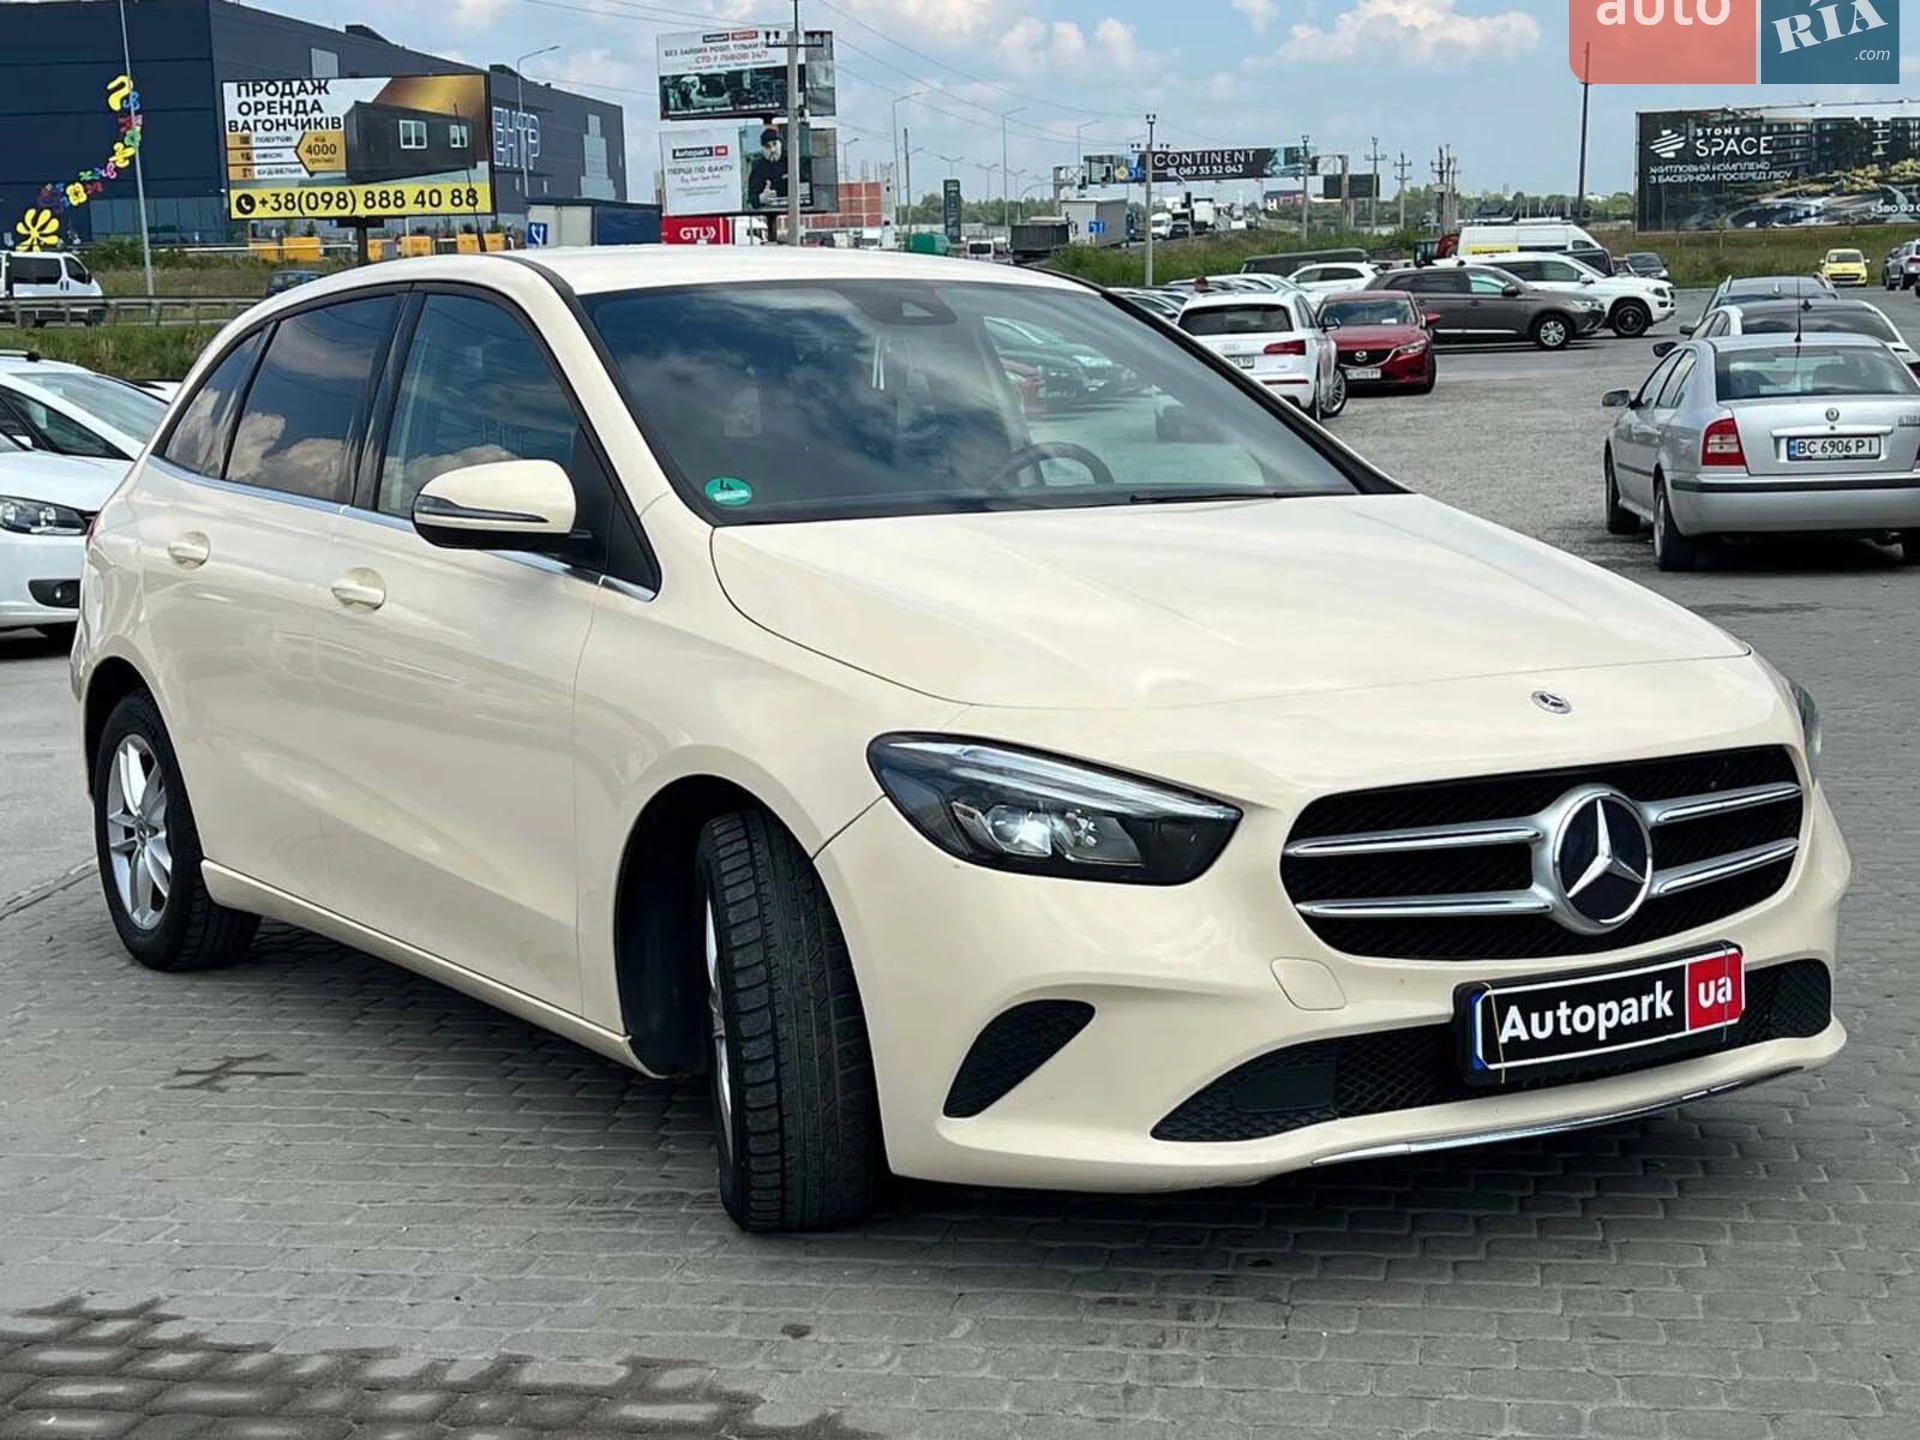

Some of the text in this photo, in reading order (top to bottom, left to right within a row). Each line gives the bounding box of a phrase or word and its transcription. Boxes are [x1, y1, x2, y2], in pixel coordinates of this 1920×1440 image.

[237, 80, 330, 99] ПРОДАЖ
[238, 99, 324, 117] ОРЕНДА
[228, 116, 342, 133] ВАГОНЧИКІВ
[1696, 126, 1741, 137] STONE
[305, 143, 337, 156] 4000
[675, 148, 711, 158] Autopark
[1696, 135, 1774, 157] SPACE
[1153, 149, 1256, 167] CONTINENT
[1179, 163, 1244, 176] 067 33 32 043
[259, 188, 479, 216] +38(098) 888 40 88
[1797, 440, 1873, 454] BC 6906 PI
[1500, 976, 1733, 1044] Autopark ua
